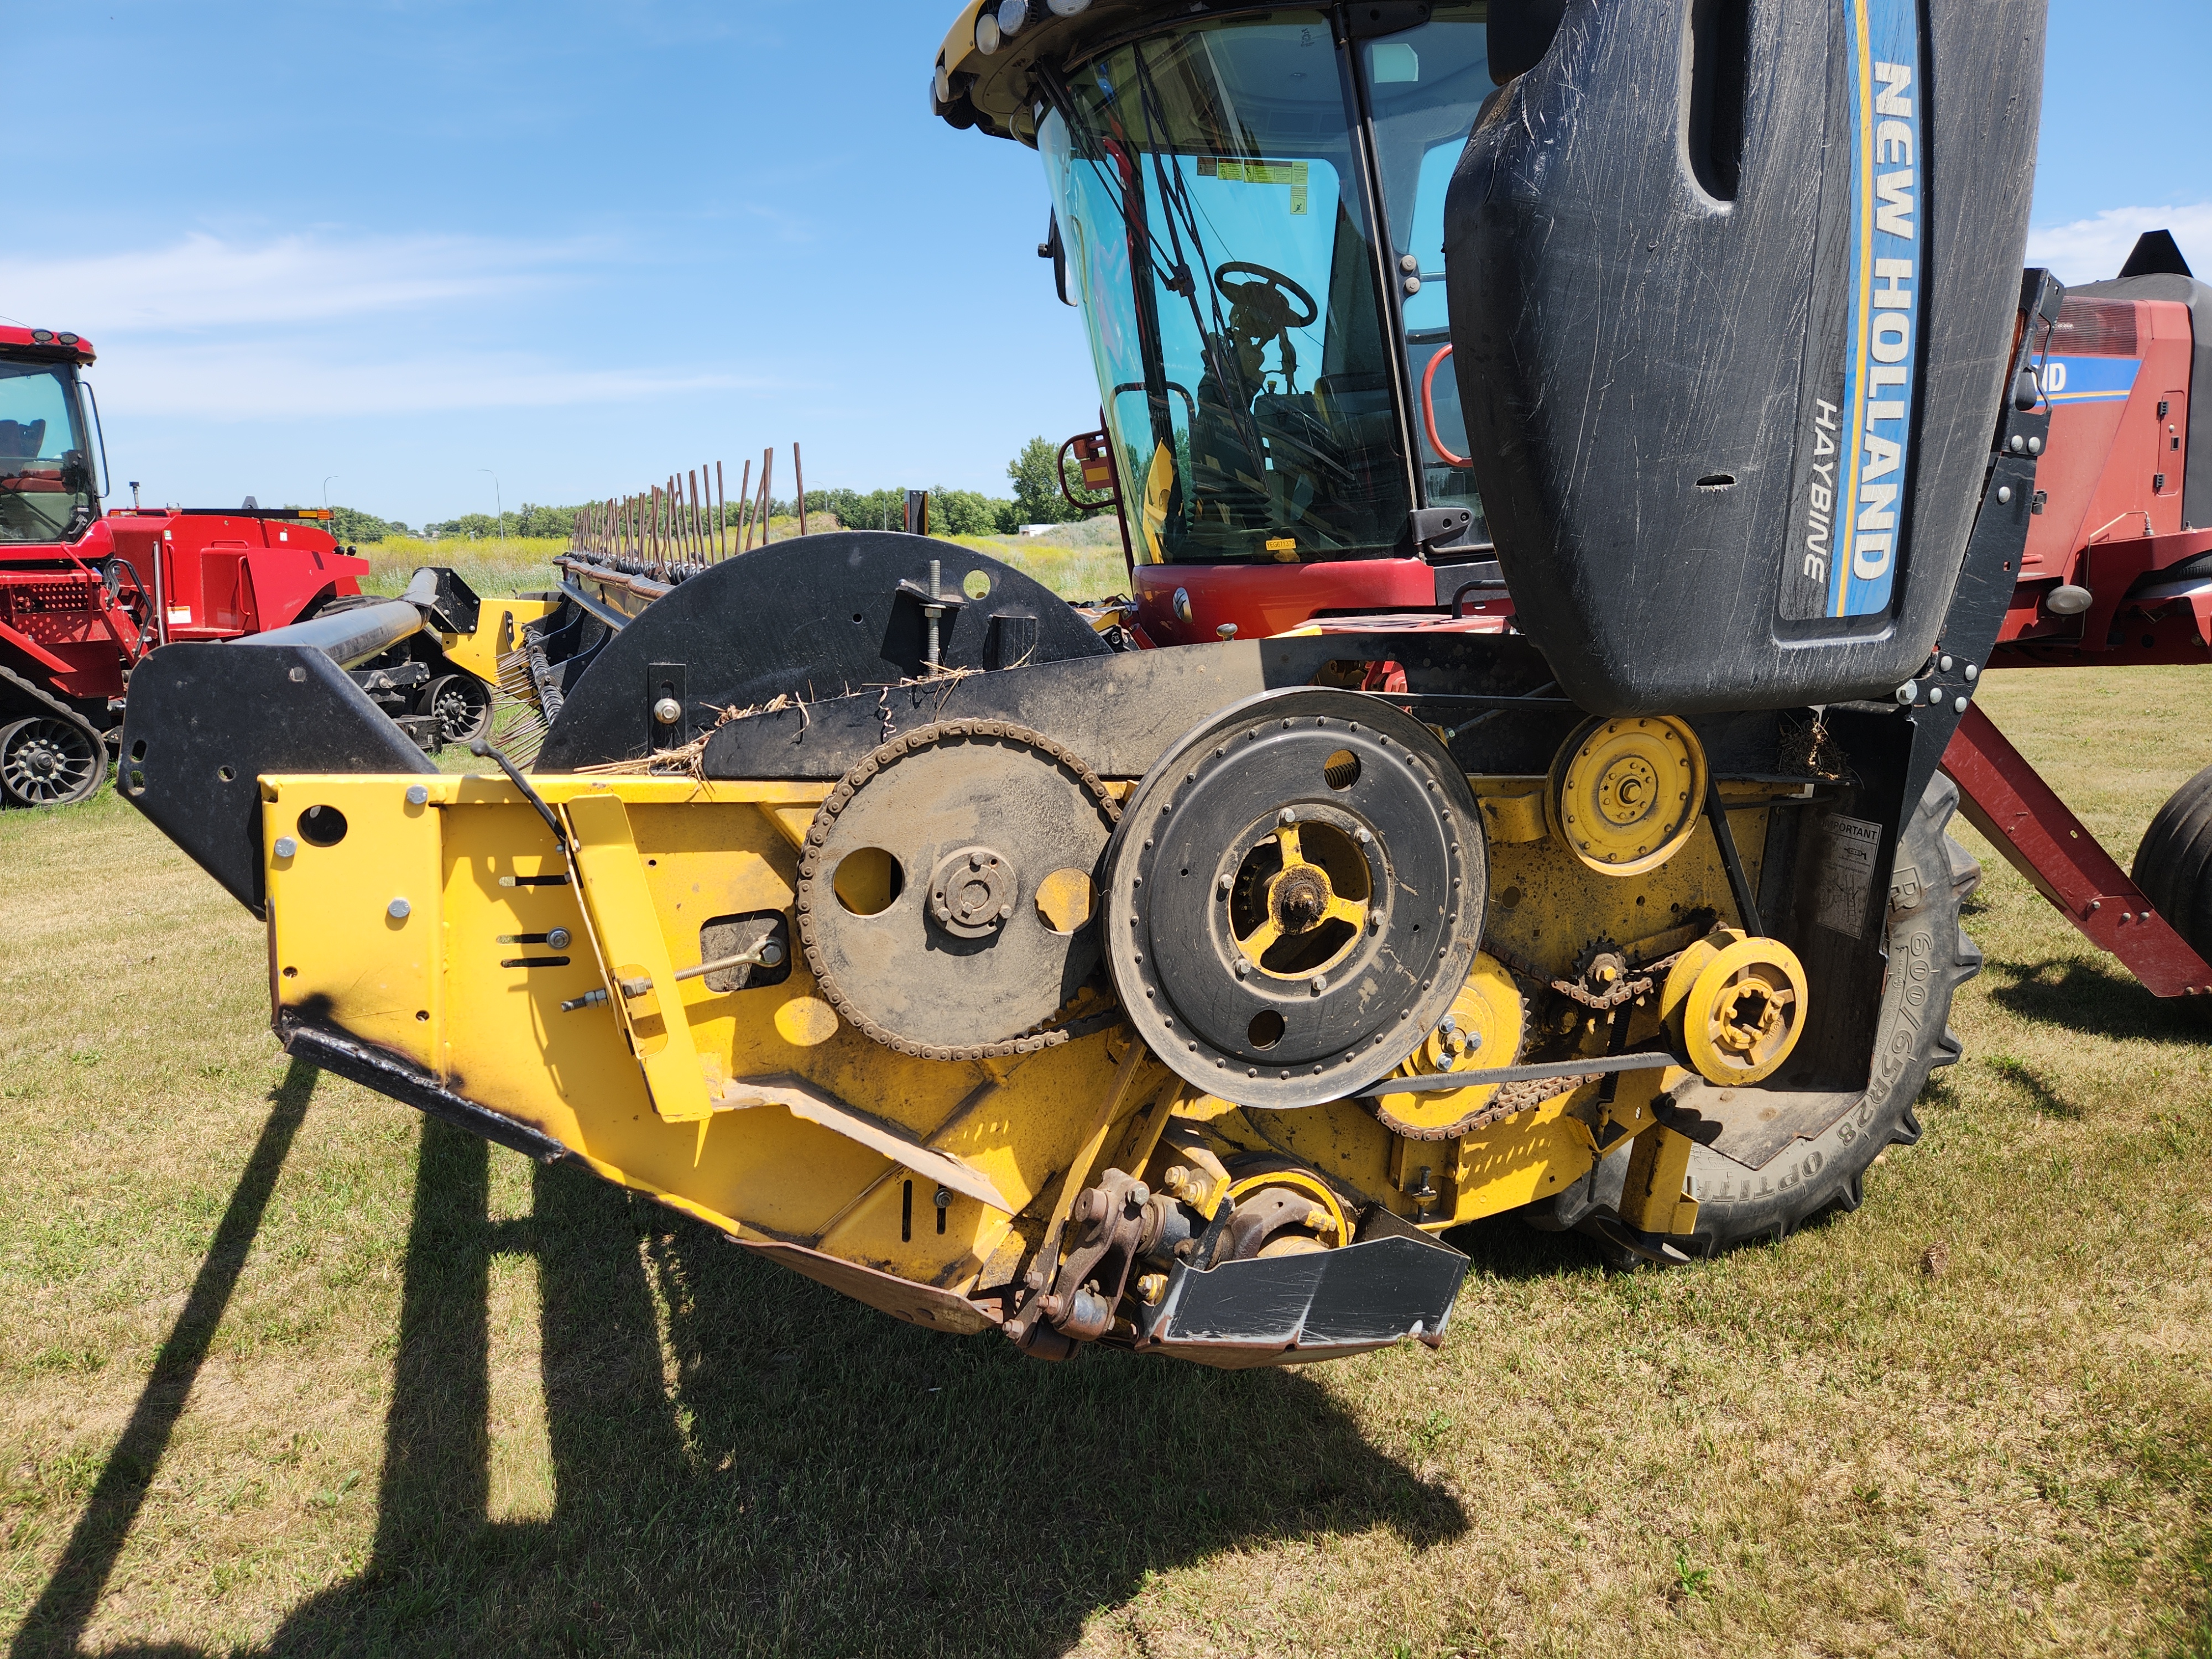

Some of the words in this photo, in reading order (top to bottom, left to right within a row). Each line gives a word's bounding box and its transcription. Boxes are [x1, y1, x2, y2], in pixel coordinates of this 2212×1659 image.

[1874, 61, 1914, 240] NEW
[1804, 398, 1837, 583] HAYBINE
[1852, 258, 1912, 580] HOLLAND
[1822, 820, 1877, 839] IMPORTANT
